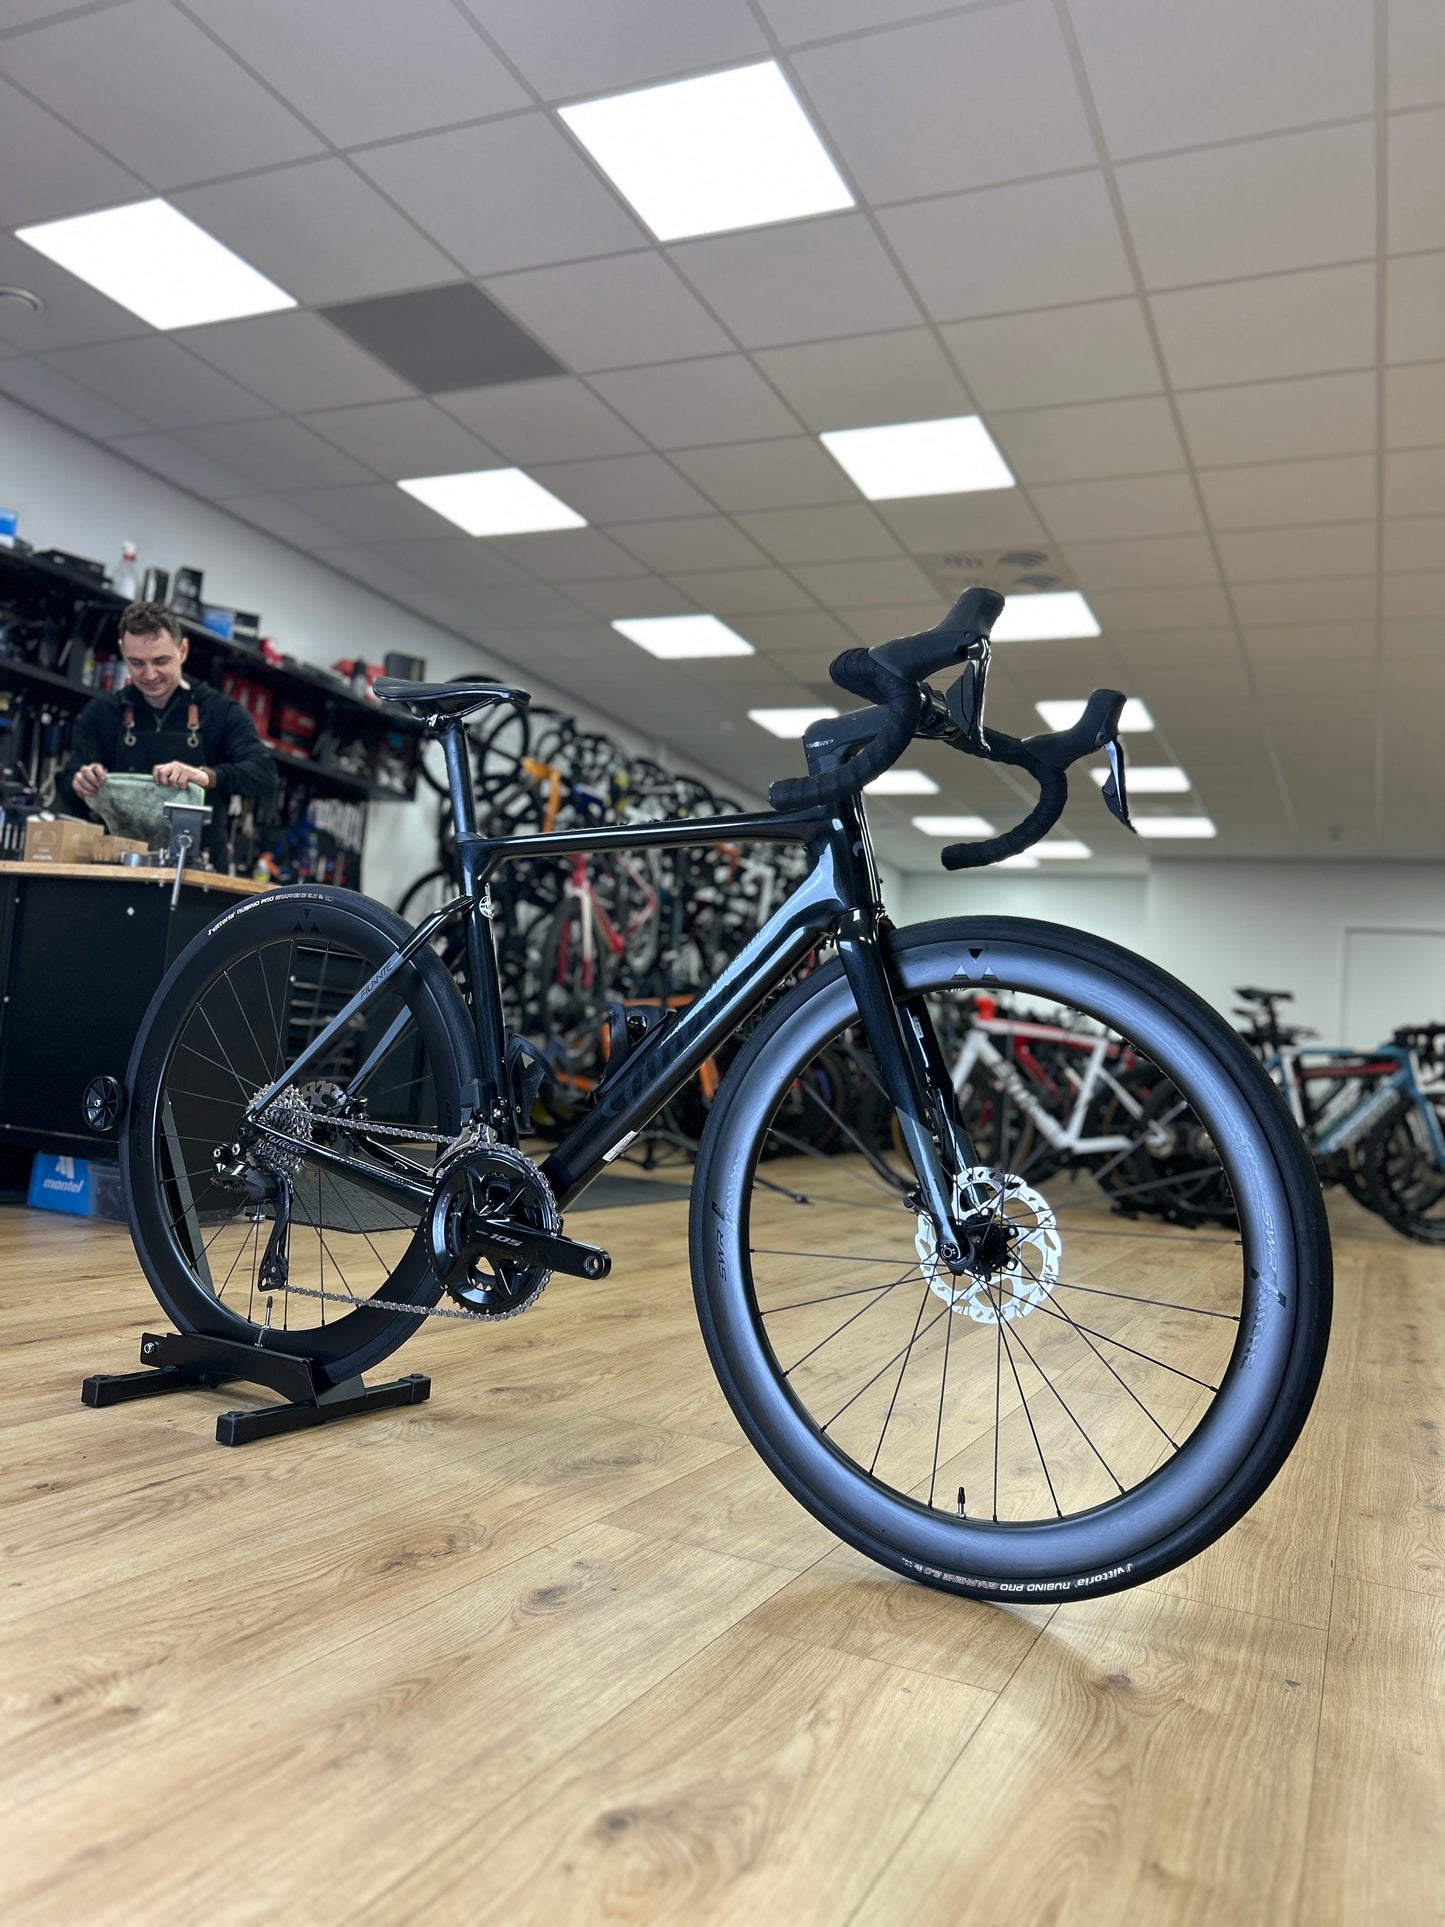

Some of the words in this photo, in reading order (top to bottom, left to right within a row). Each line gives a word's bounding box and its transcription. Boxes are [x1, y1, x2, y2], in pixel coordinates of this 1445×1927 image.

[261, 896, 275, 905] PRO
[360, 961, 392, 1000] FILANTE
[42, 1178, 84, 1194] mantel
[488, 1233, 523, 1247] 105
[1262, 1209, 1278, 1273] SWR
[716, 1229, 728, 1282] SWR
[1077, 1566, 1125, 1586] vittoria
[1000, 1583, 1024, 1592] PRO
[1026, 1581, 1071, 1592] RUBINO
